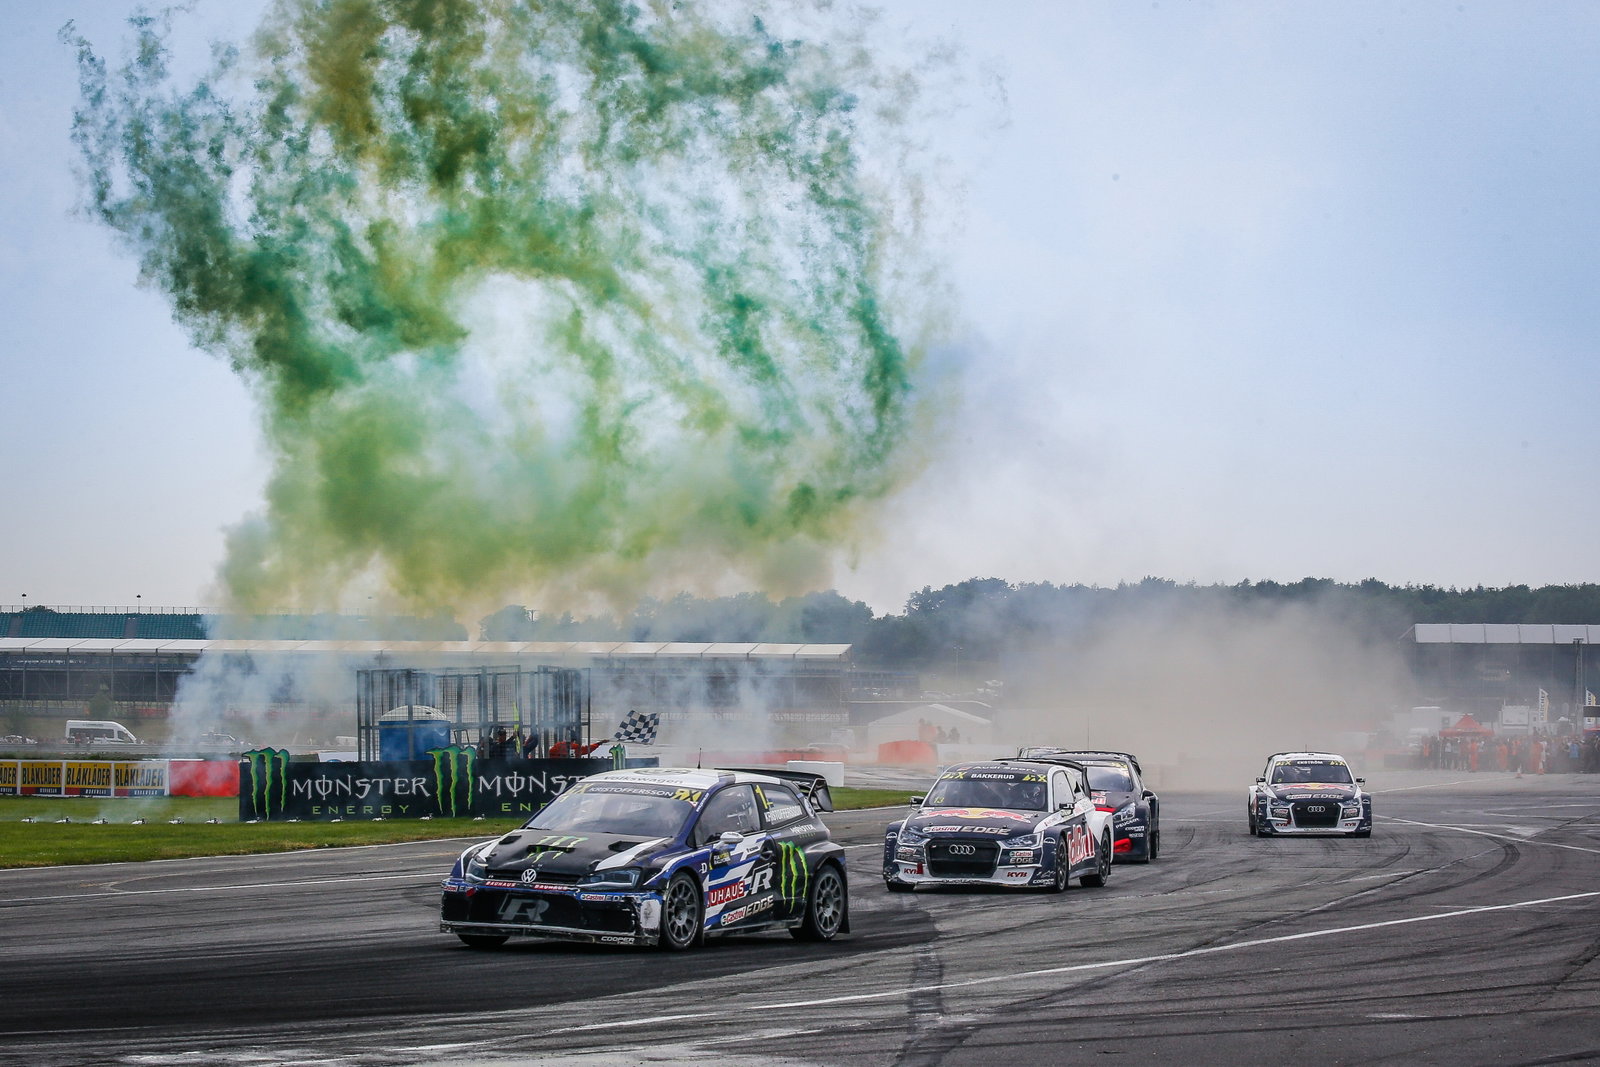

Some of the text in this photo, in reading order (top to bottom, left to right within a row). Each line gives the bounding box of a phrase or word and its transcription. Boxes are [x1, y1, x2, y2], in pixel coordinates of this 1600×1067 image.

[22, 763, 61, 785] BLÅKLÄDER
[66, 763, 111, 786] BLÅKLÄDER
[115, 764, 164, 787] BLÅKLÄDER
[604, 775, 684, 785] Volkswagen
[292, 773, 430, 801] MONSTER
[590, 787, 674, 797] KRISTOFFERSSON
[312, 804, 410, 815] ENERGY
[960, 826, 1011, 836] EDGE
[724, 894, 774, 924] Castrol EDGE
